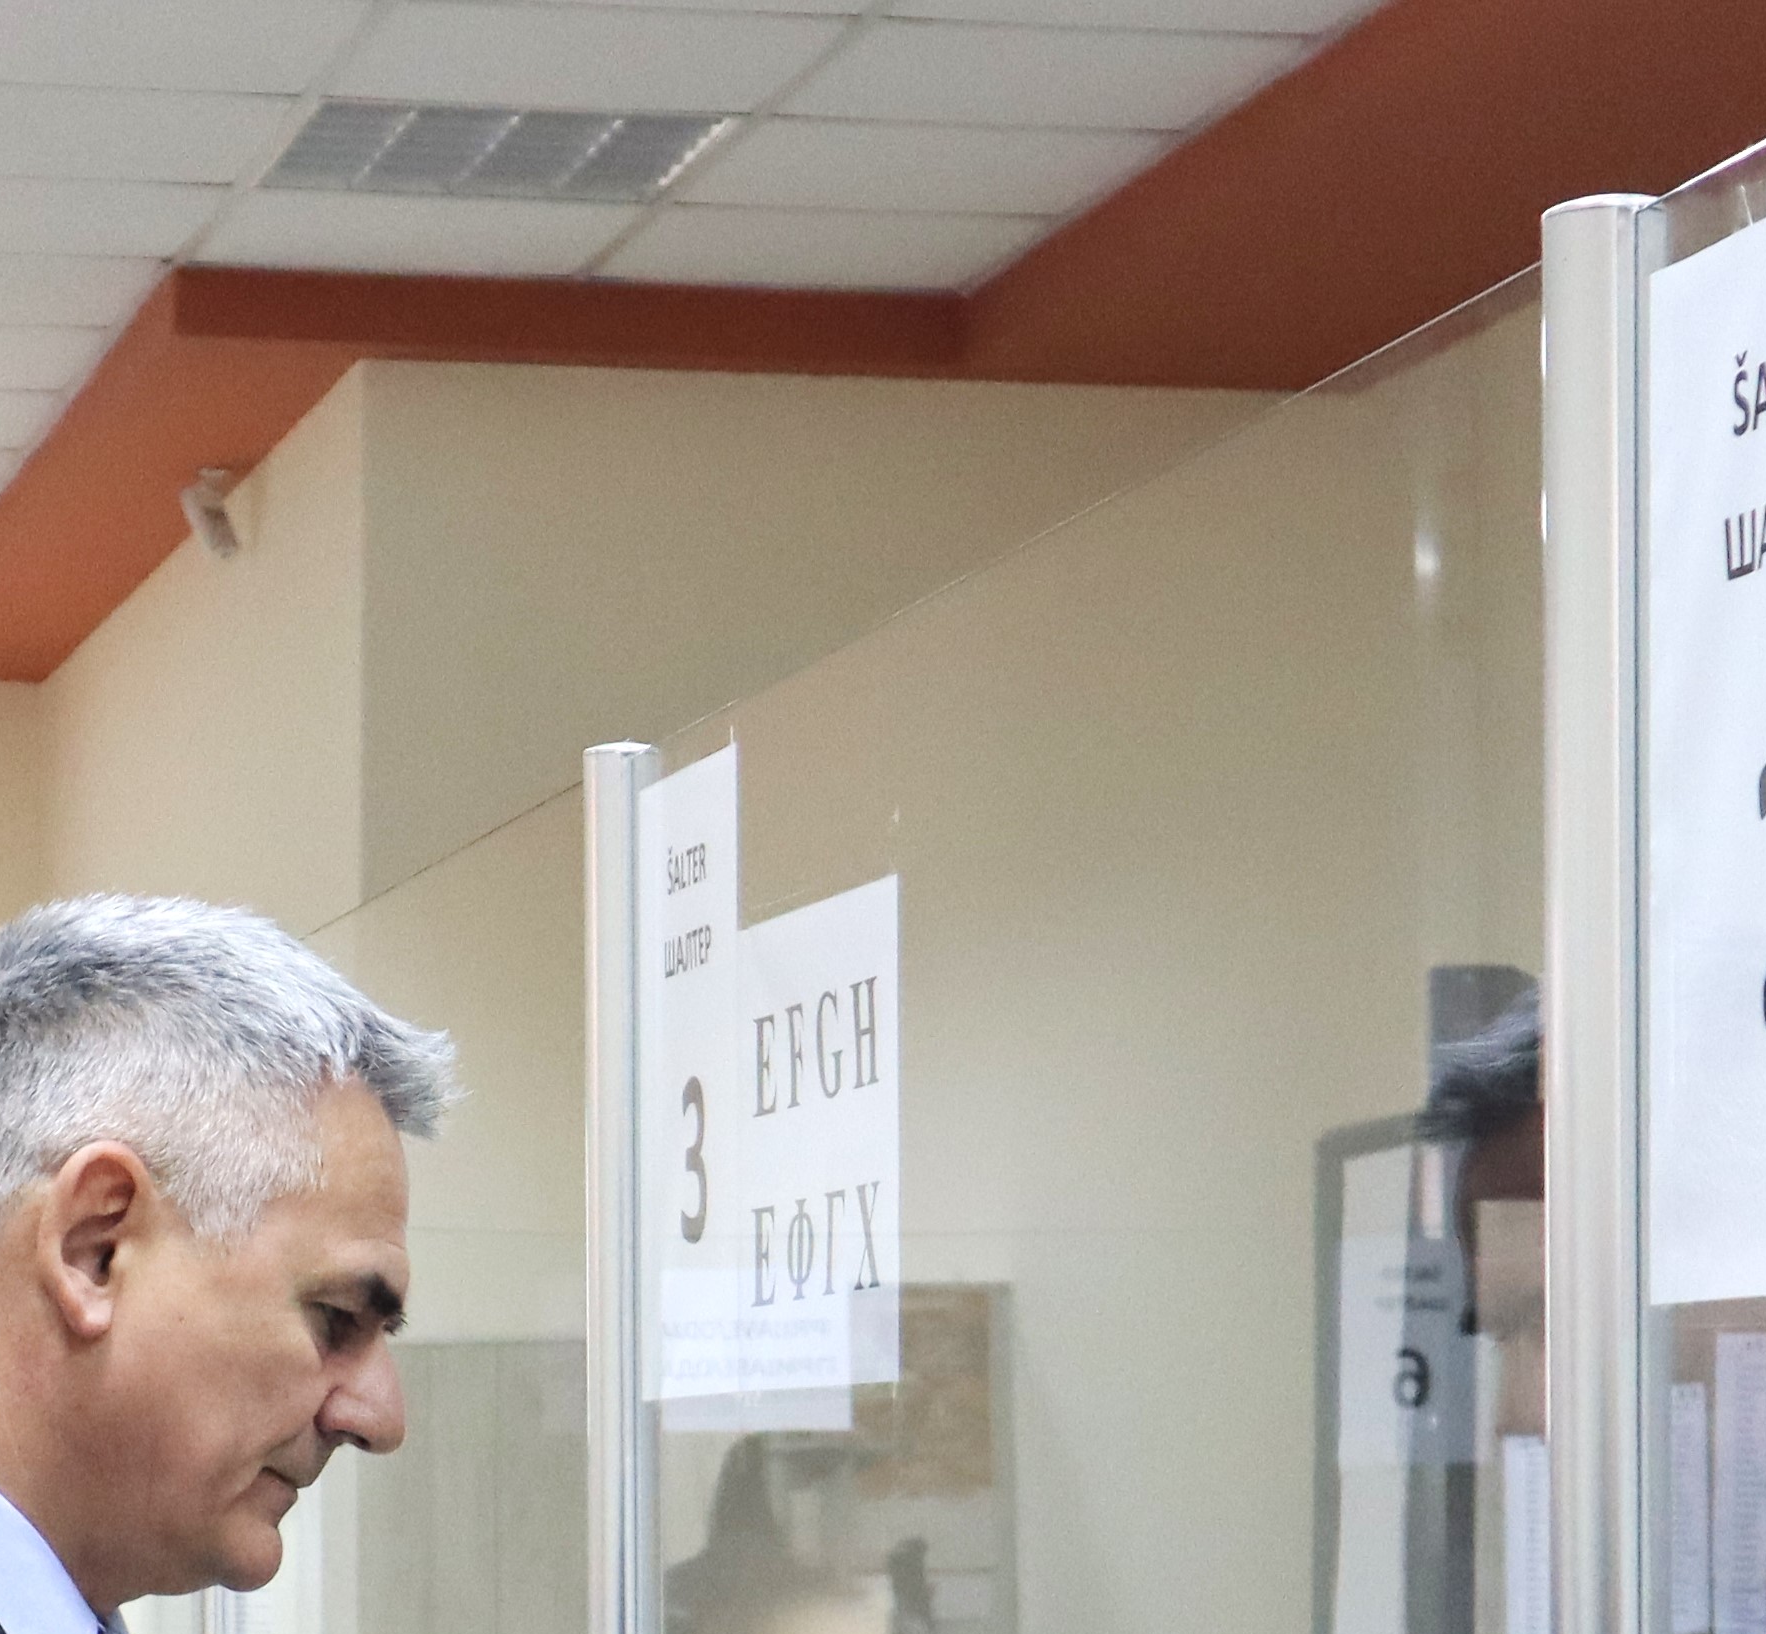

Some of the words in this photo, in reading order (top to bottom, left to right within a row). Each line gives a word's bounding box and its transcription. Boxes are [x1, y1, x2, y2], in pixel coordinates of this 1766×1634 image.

[667, 842, 708, 896] ŠALTER
[664, 924, 712, 979] ШАЛТЕР
[680, 1074, 709, 1245] 3
